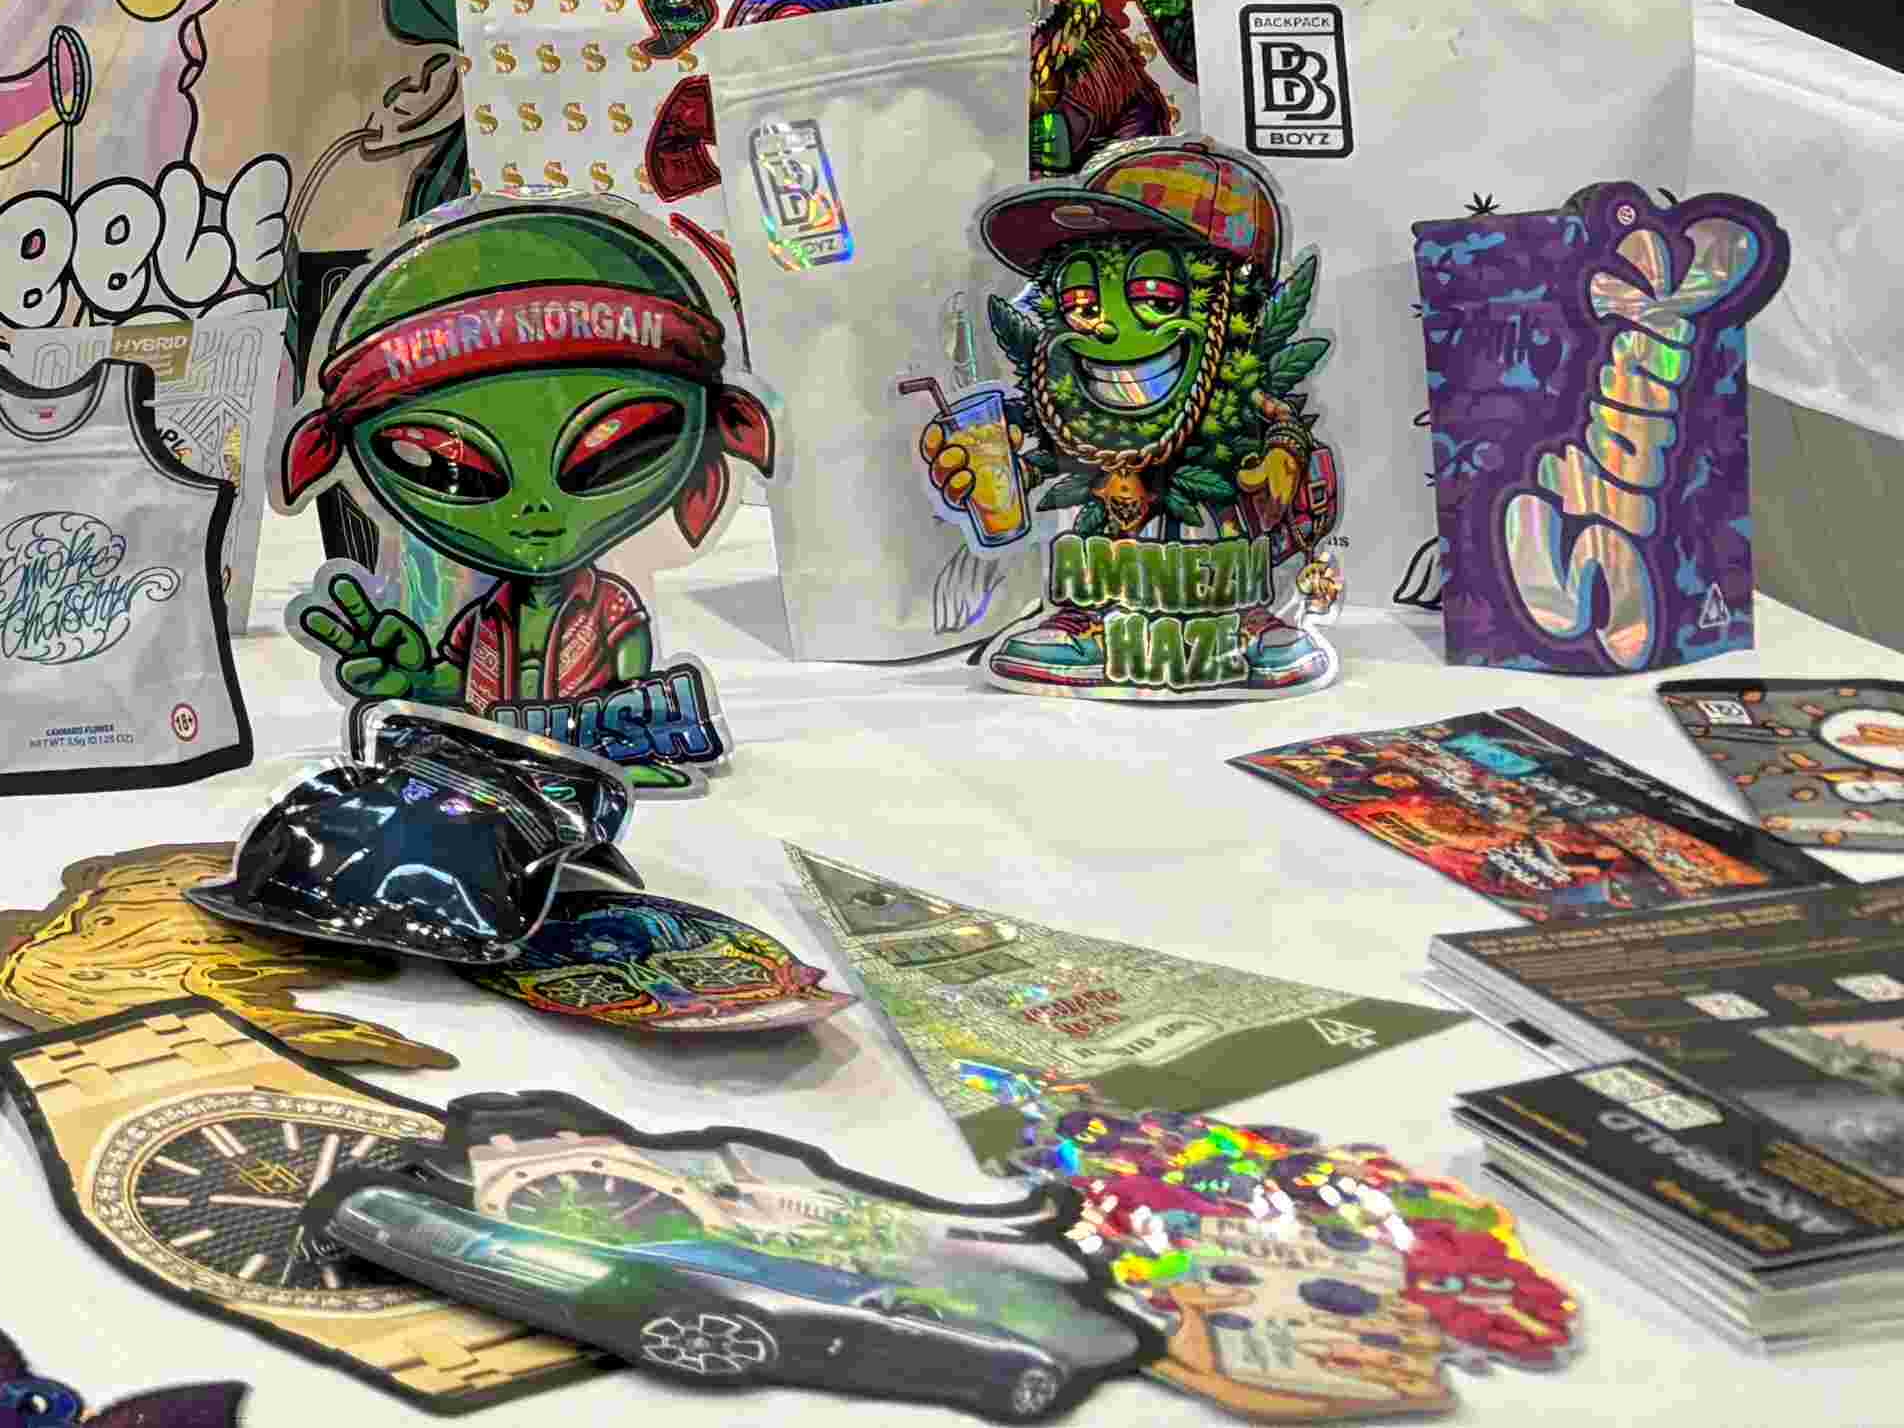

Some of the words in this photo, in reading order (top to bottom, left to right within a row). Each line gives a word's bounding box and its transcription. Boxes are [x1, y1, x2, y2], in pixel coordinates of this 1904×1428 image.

[1252, 15, 1331, 28] BACKPACK
[1269, 130, 1331, 146] BOYZ
[112, 334, 189, 354] HYBRID
[381, 308, 504, 379] HENRY
[514, 298, 664, 349] MORGAN
[1106, 616, 1249, 688] HAZE
